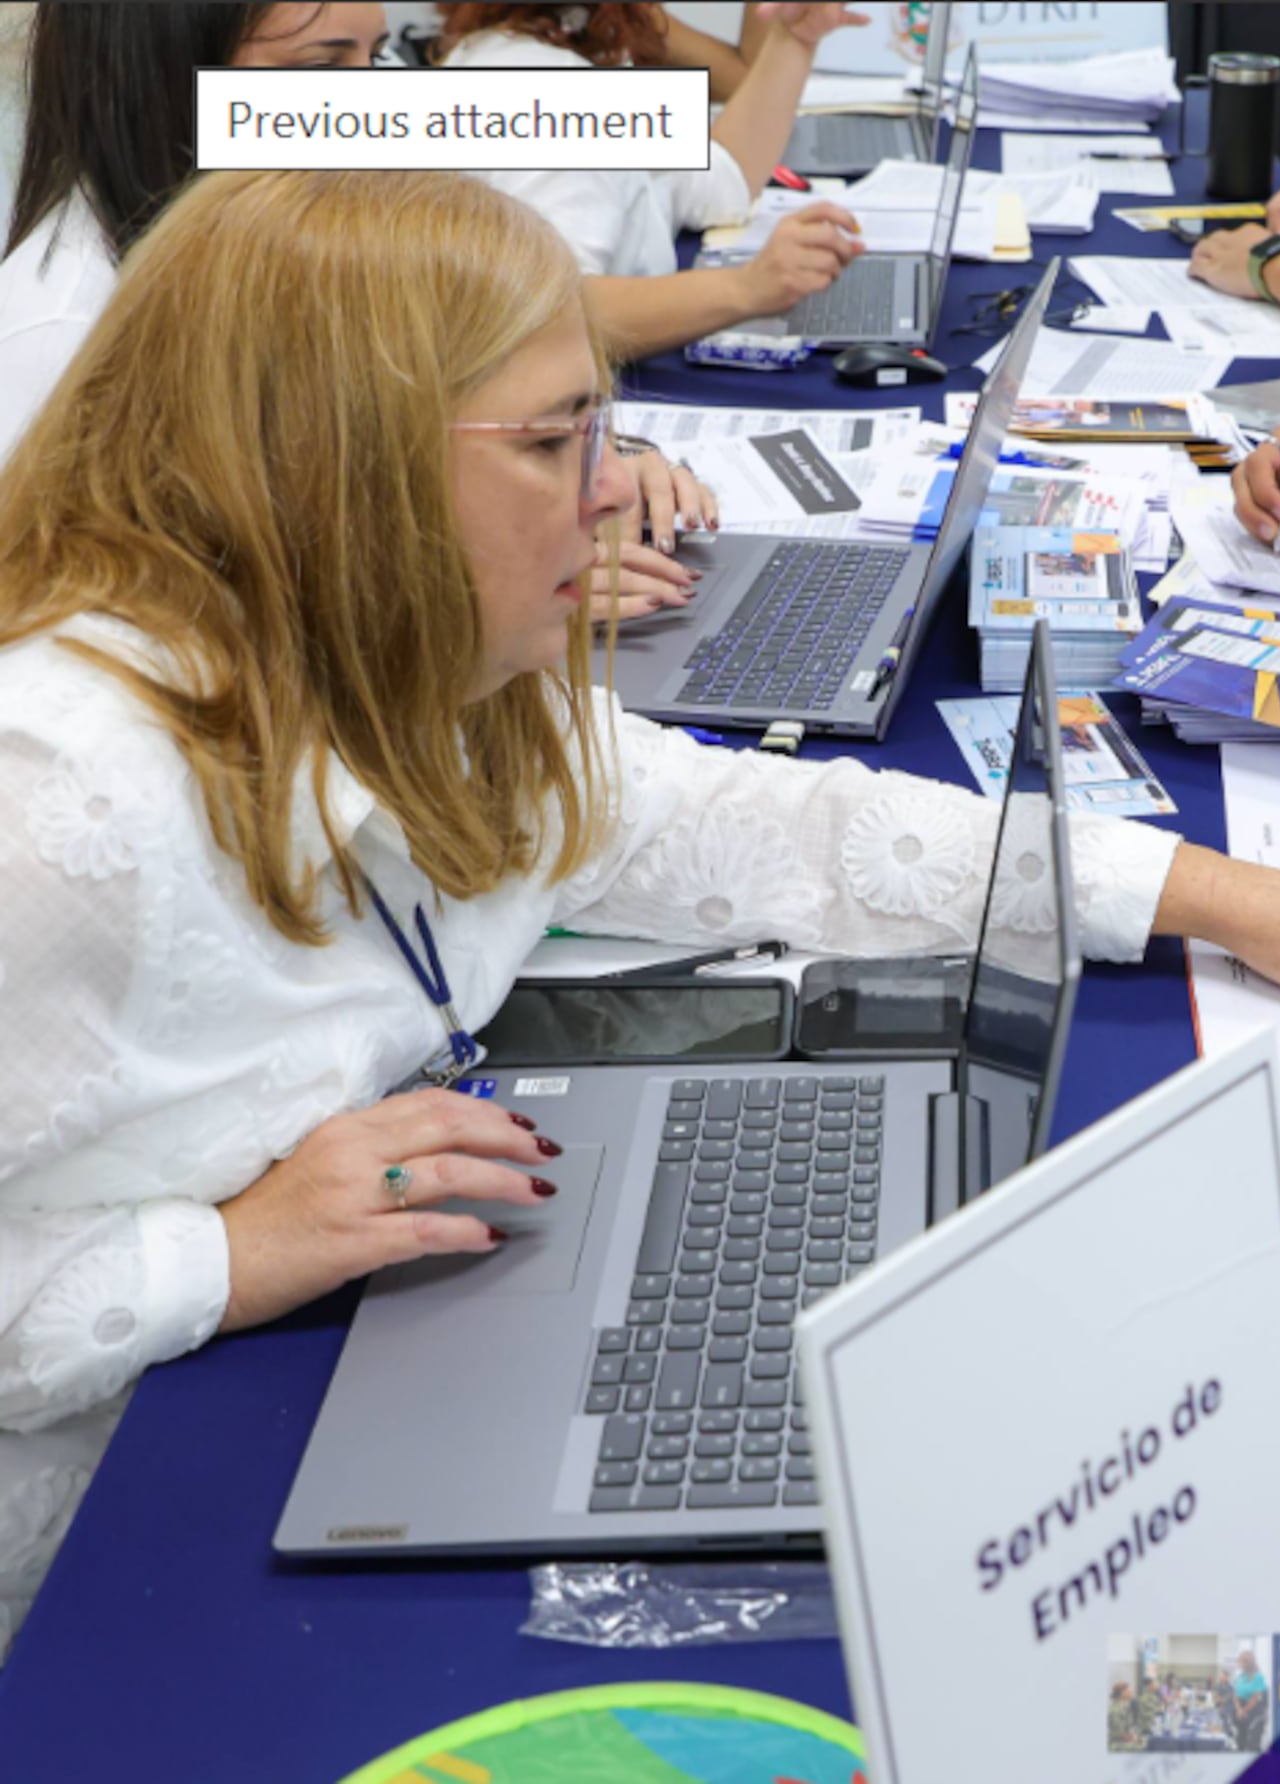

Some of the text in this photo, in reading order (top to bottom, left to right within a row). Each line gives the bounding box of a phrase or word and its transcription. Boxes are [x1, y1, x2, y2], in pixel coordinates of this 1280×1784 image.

[976, 1377, 1221, 1591] Servicio de
[1030, 1484, 1196, 1642] Empleo
